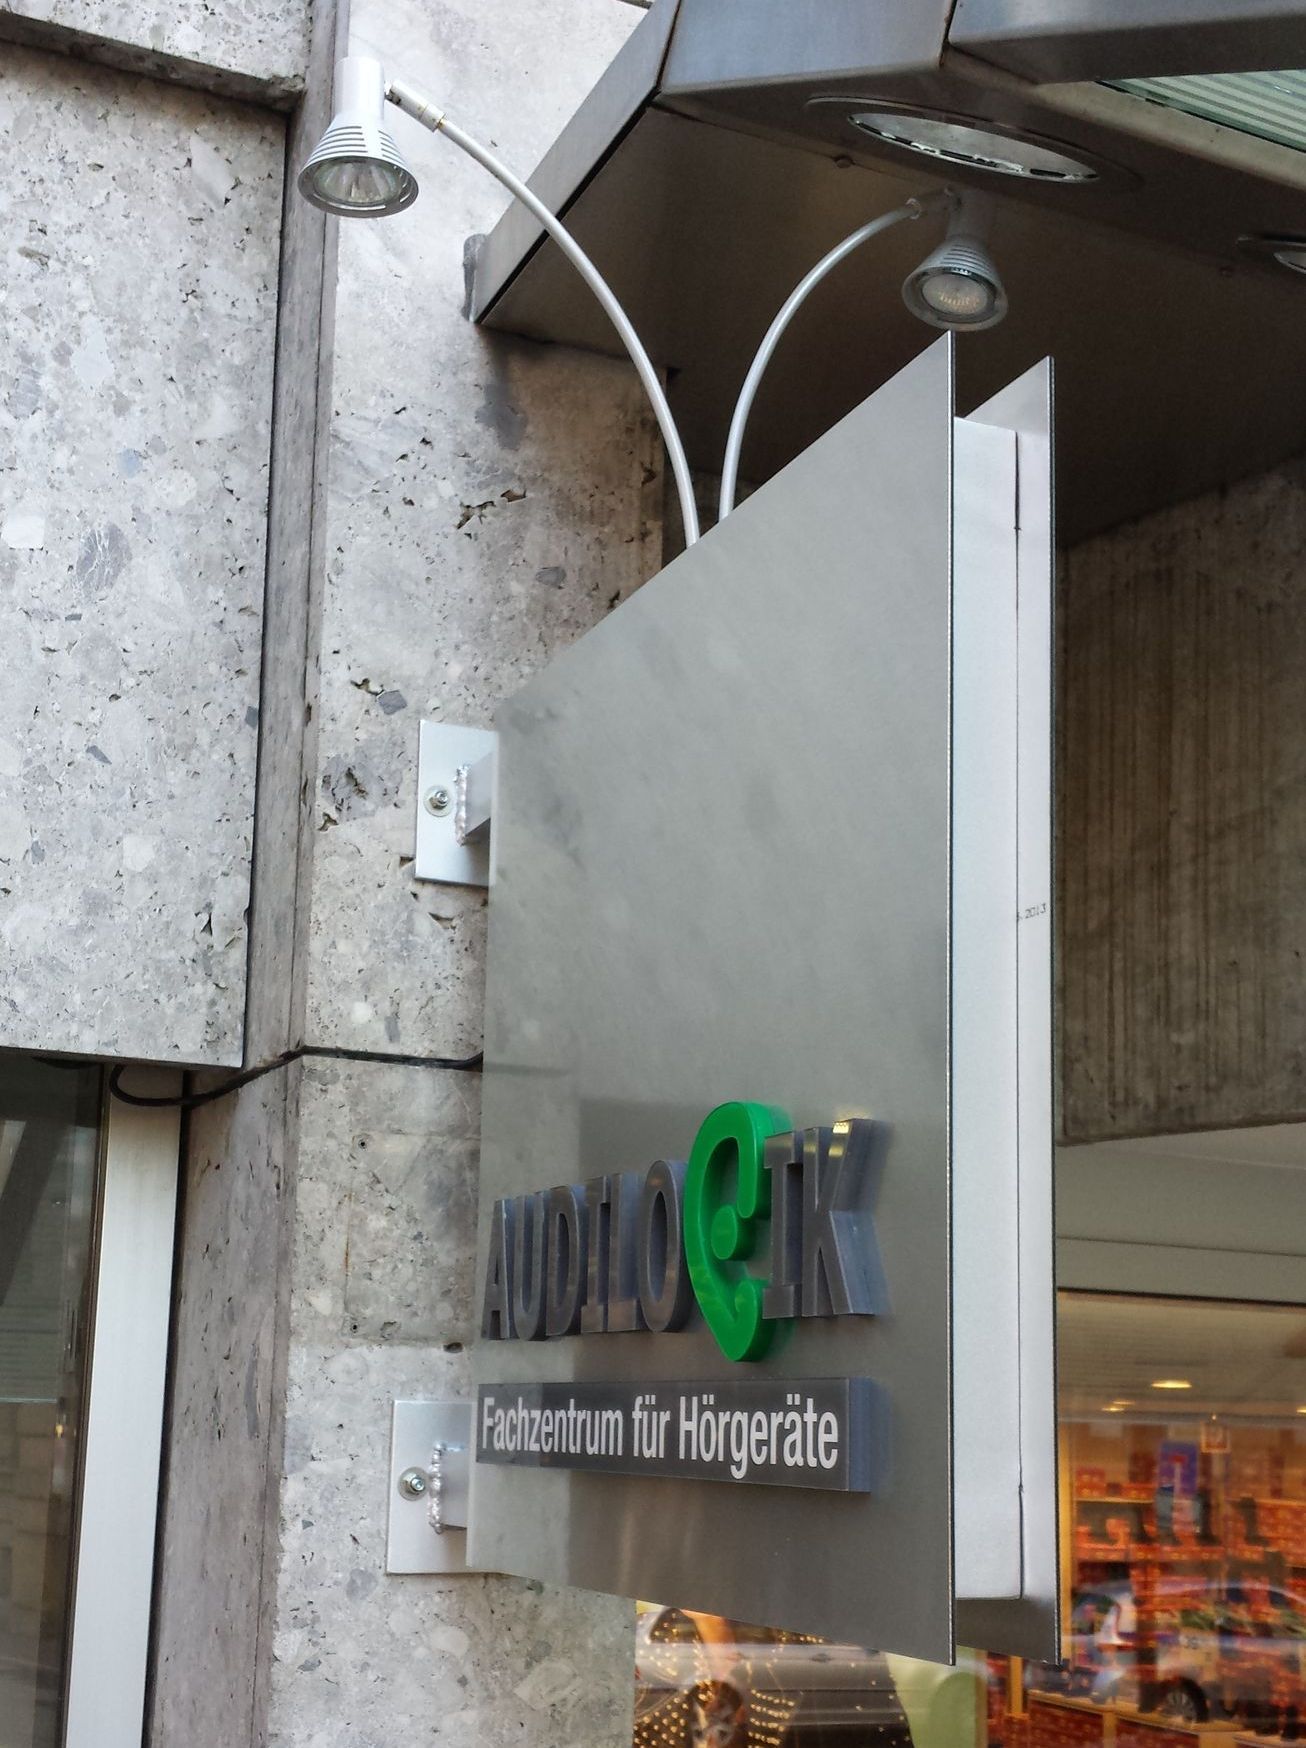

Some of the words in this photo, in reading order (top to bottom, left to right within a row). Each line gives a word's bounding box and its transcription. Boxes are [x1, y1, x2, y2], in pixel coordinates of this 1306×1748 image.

[482, 1396, 624, 1456] Fachzentrum
[631, 1394, 671, 1459] für
[679, 1393, 839, 1480] Hörgeräte
